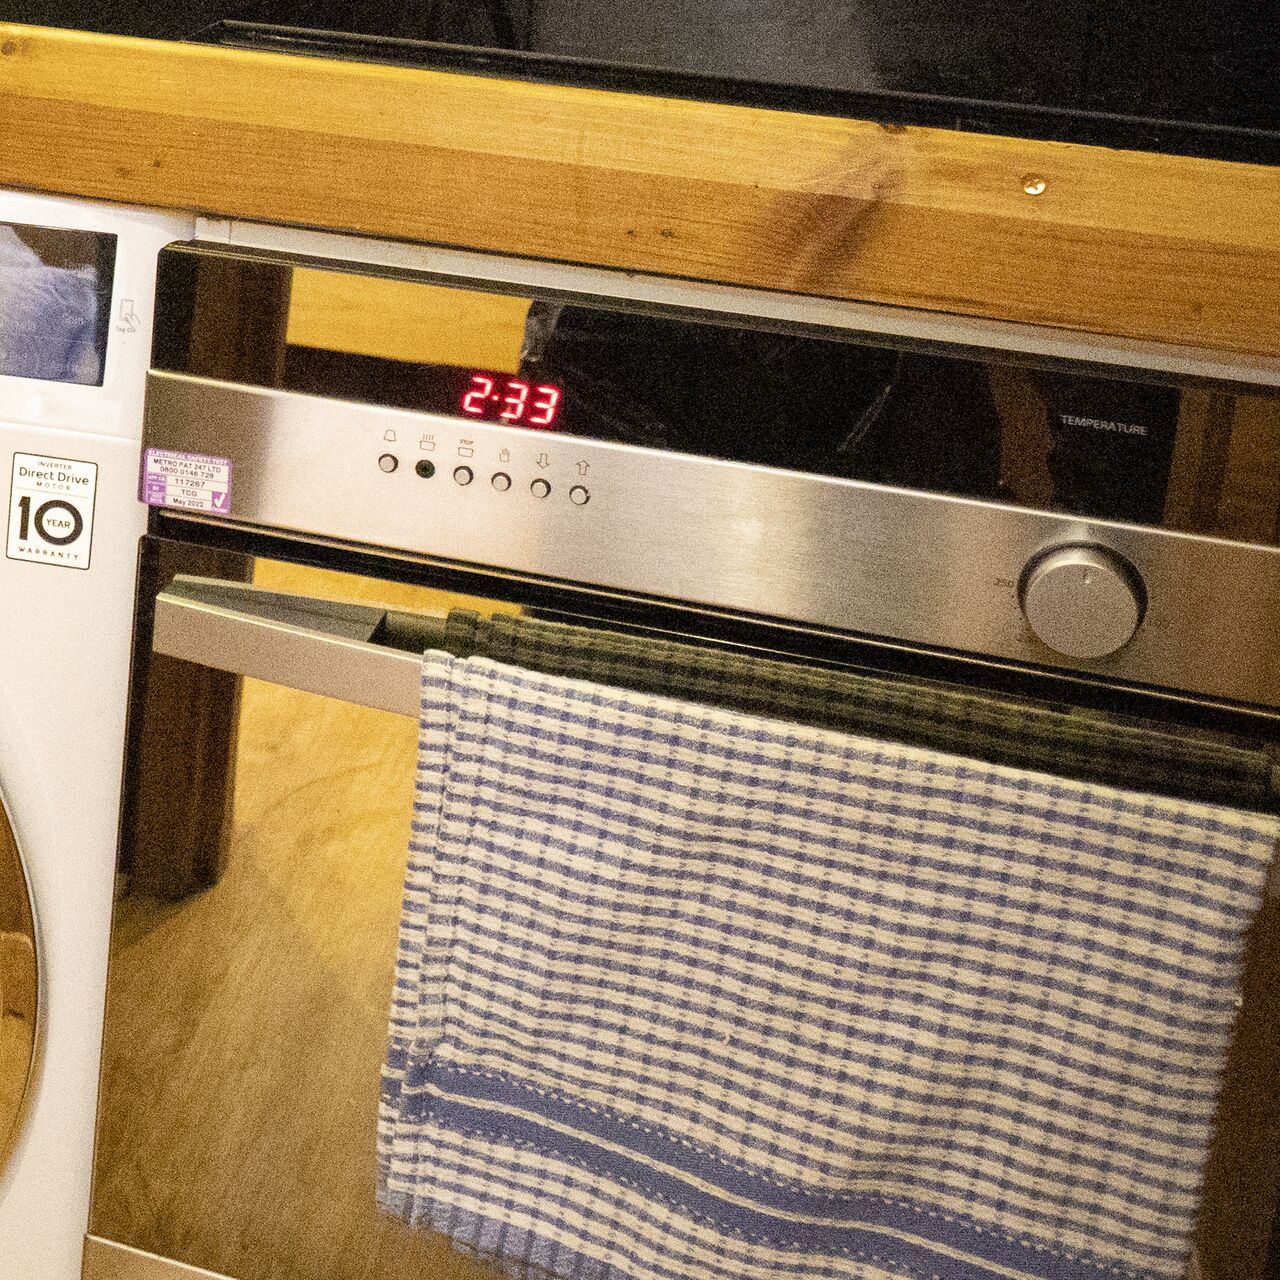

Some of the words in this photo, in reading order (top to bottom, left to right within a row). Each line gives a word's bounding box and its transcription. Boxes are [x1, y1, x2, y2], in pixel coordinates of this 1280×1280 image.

[1060, 414, 1149, 436] TEMPERATURE
[459, 438, 474, 446] STOP
[37, 461, 72, 470] INVERTER
[153, 458, 178, 467] METRO
[19, 466, 54, 480] Direct
[57, 472, 89, 486] Drive
[160, 466, 178, 474] 0800
[180, 469, 199, 477] 0146
[36, 481, 71, 490] MOTOR
[181, 489, 198, 497] TCG
[173, 497, 186, 506] May
[188, 500, 204, 508] 2022
[18, 496, 83, 546] 10
[46, 518, 71, 529] YEAR
[18, 546, 79, 561] WARRANTY
